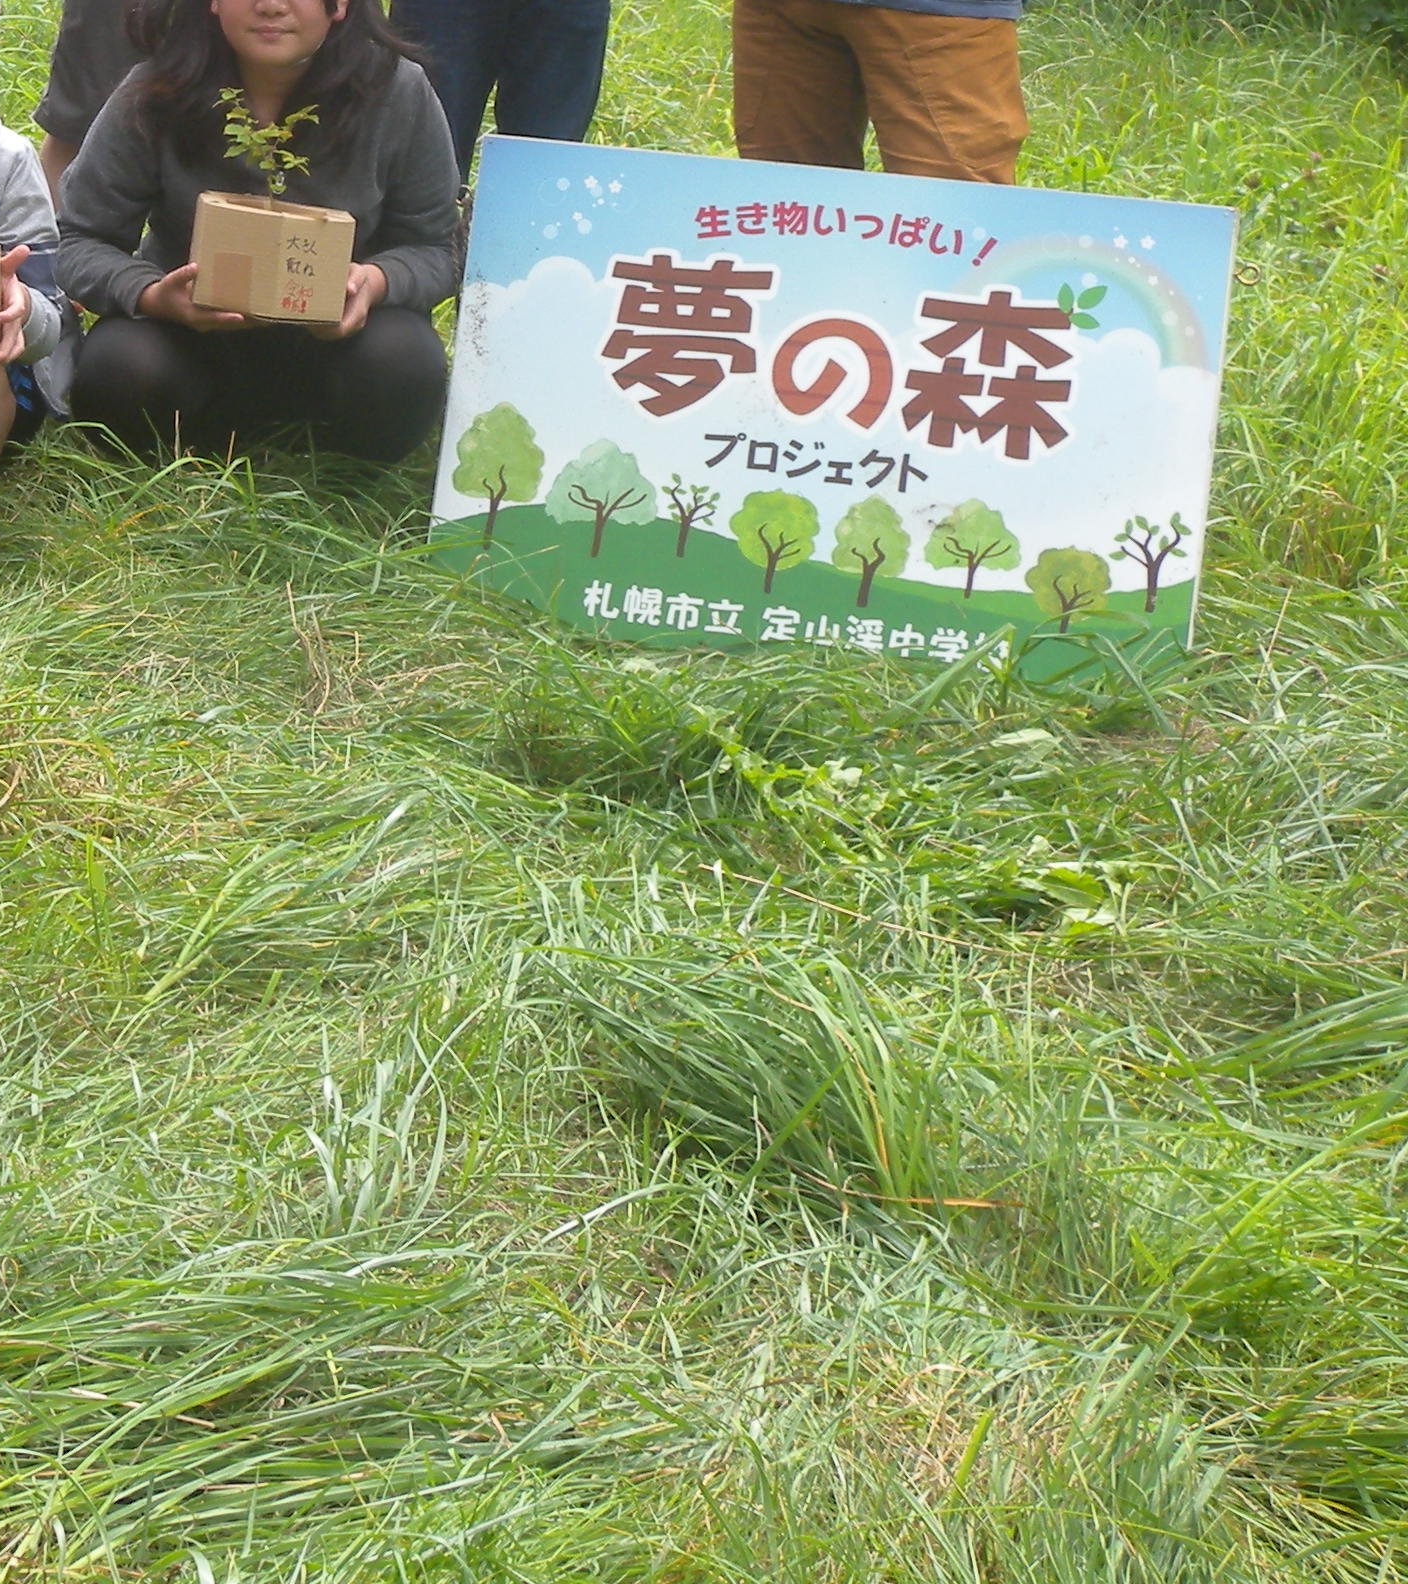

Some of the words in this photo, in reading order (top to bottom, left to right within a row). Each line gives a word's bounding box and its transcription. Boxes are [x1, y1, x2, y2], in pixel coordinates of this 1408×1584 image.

[601, 254, 1074, 461] 夢の森
[703, 432, 929, 494] プロジェクト
[584, 579, 745, 636] 札幌市立
